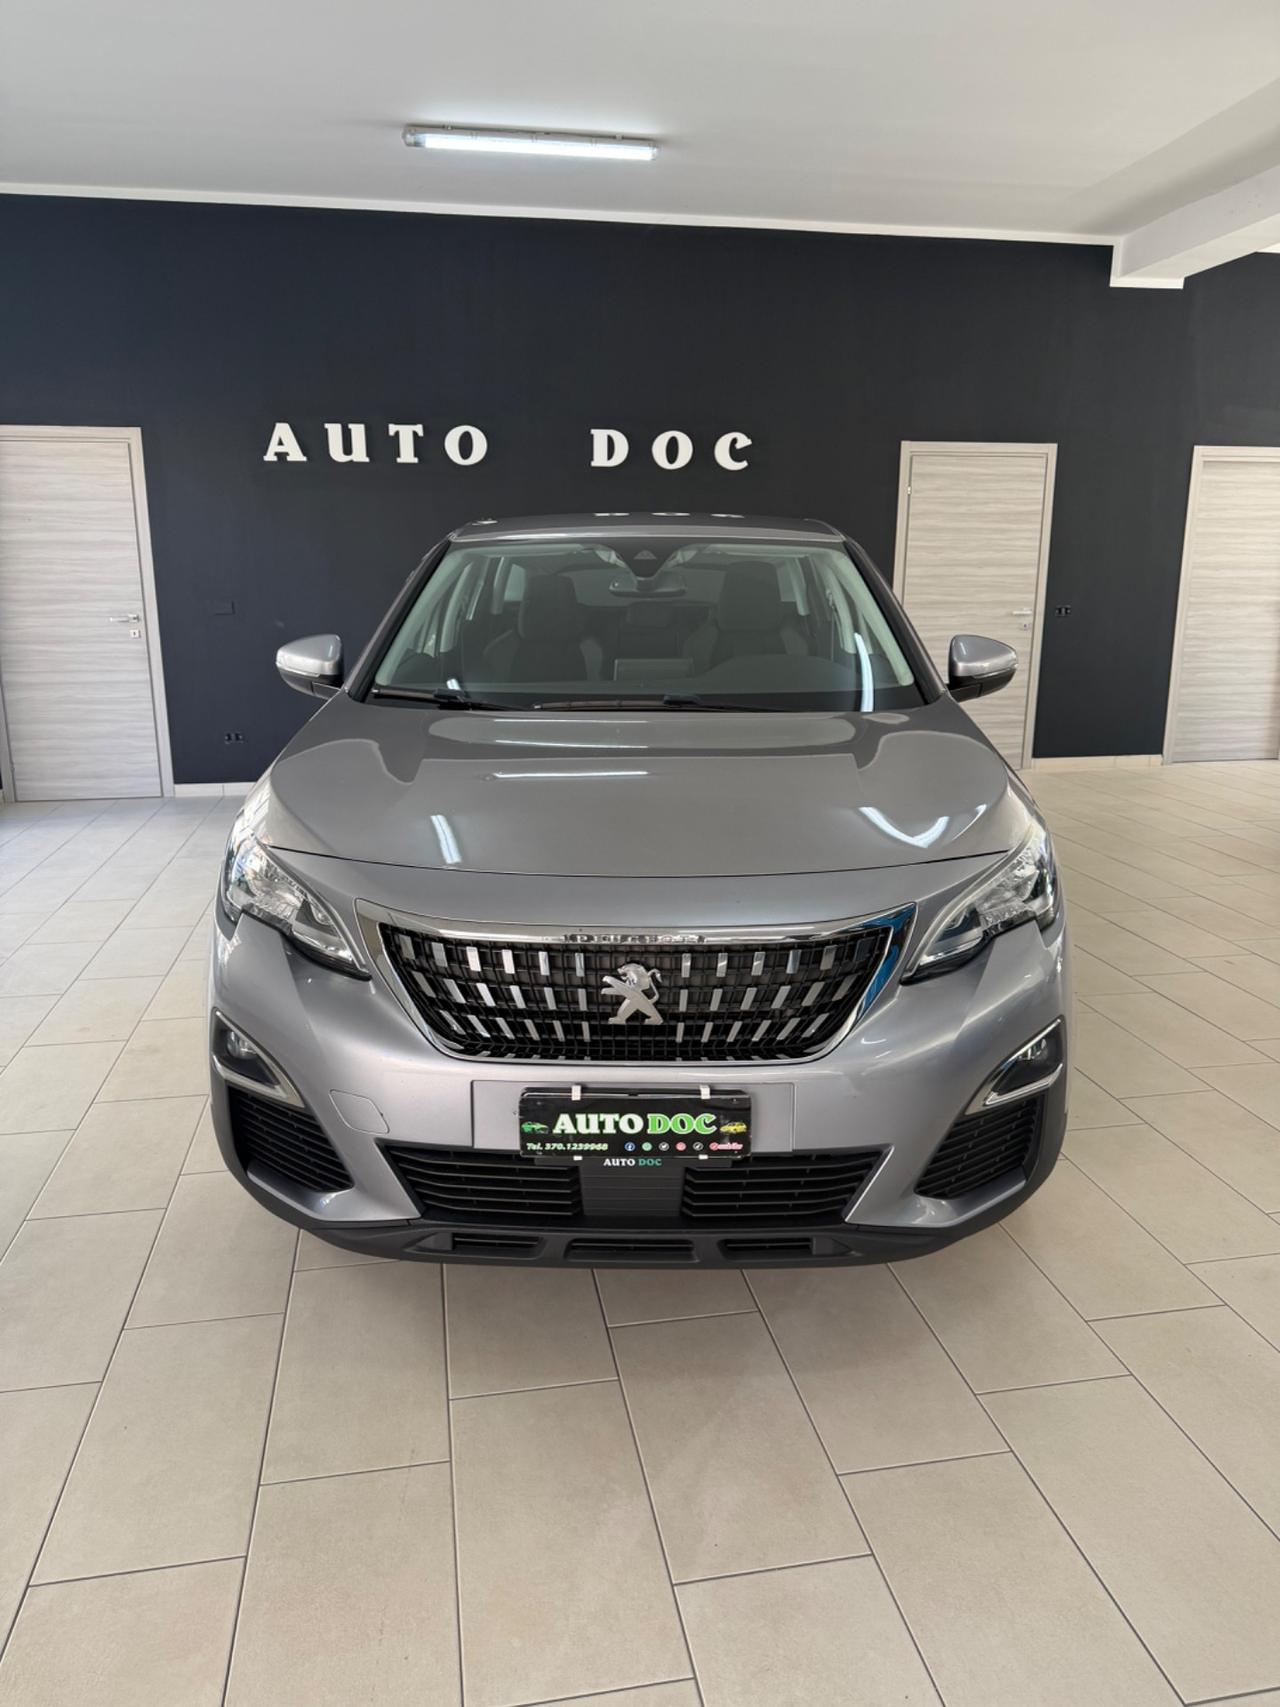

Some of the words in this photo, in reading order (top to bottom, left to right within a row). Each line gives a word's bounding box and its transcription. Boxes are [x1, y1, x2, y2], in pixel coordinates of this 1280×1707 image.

[263, 422, 488, 466] AUTO
[590, 429, 753, 471] DOC
[553, 1113, 644, 1135] AUTO
[647, 1113, 717, 1135] DOC
[603, 1158, 636, 1167] AUTO
[638, 1158, 662, 1167] DOC
